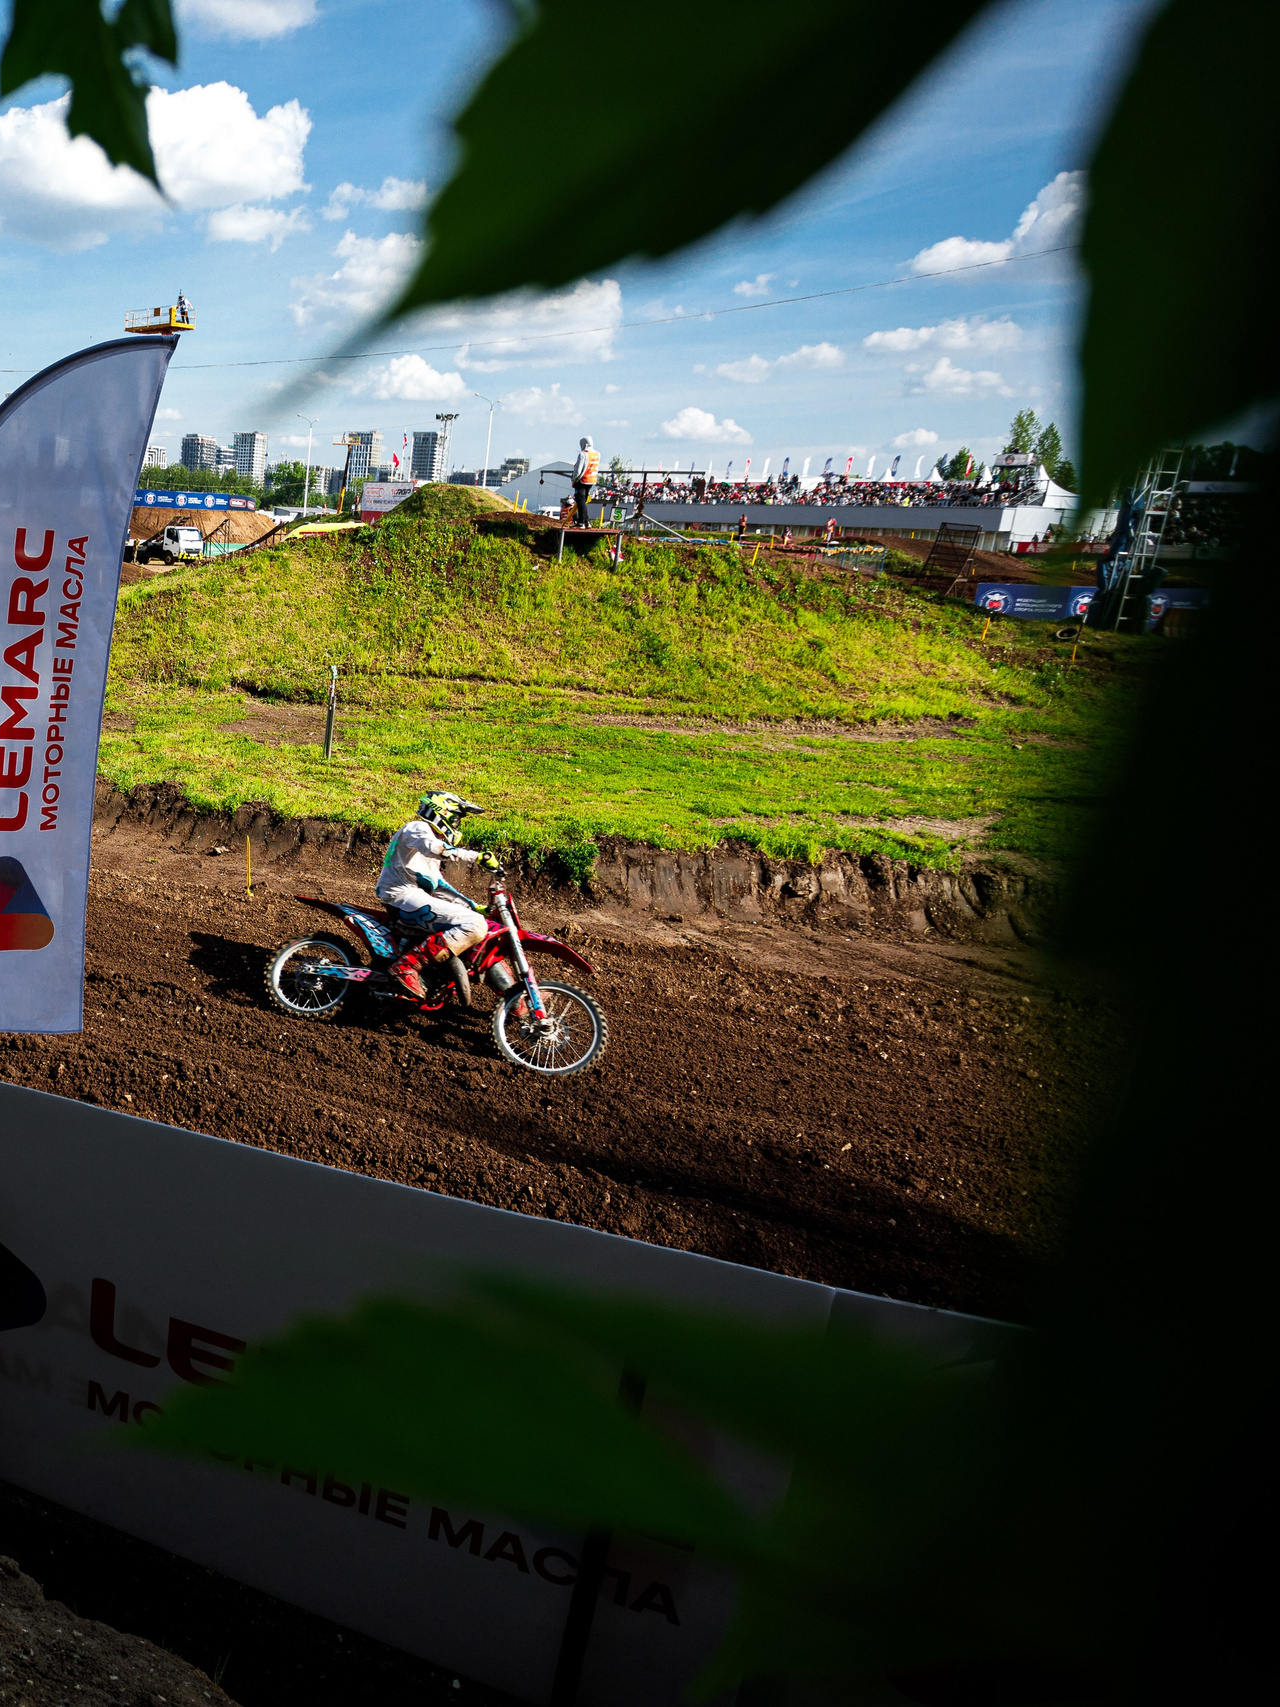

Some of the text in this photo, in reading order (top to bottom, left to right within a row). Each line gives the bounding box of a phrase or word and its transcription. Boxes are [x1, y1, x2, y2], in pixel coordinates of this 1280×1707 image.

[613, 508, 622, 520] 5
[40, 535, 89, 831] МОТОРНЫЕ МАСЛА
